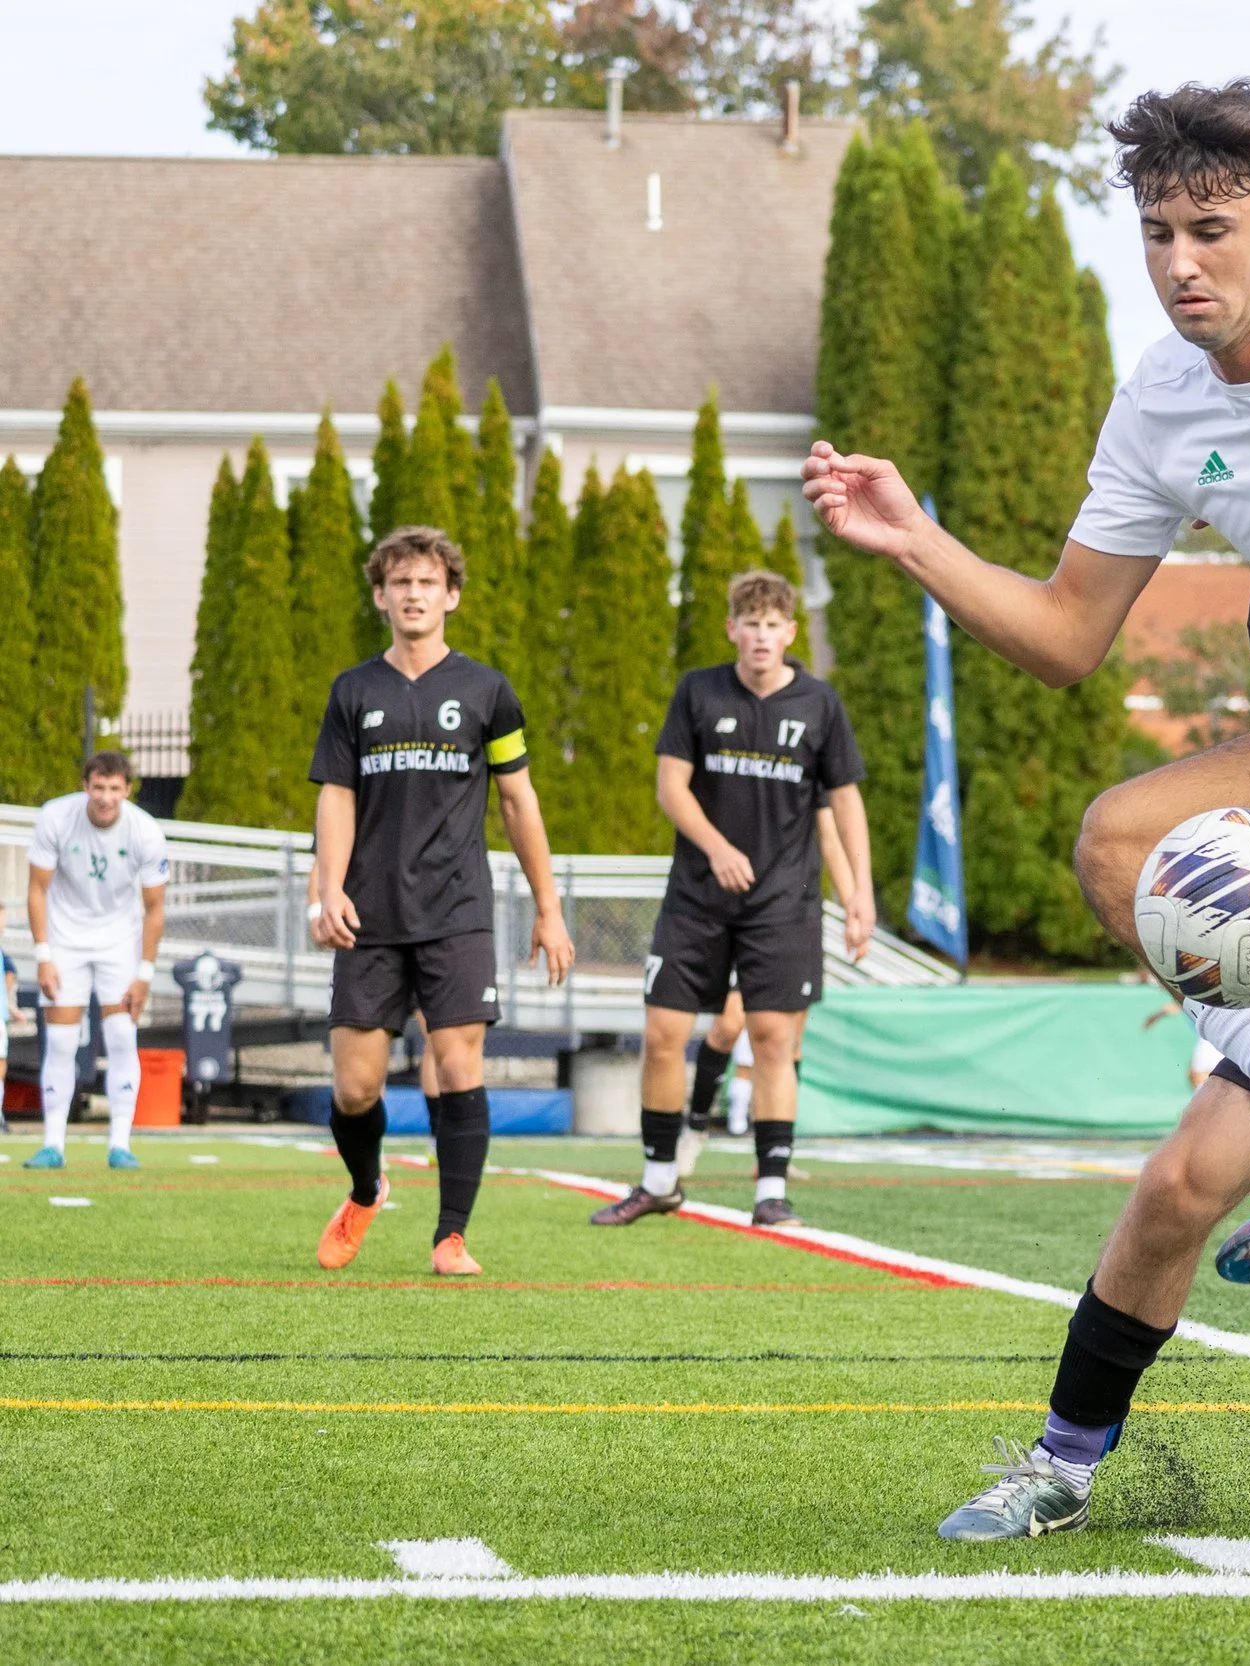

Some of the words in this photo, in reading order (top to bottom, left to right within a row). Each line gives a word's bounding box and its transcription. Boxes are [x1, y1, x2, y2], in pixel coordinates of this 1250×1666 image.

[1198, 470, 1235, 486] adidas
[437, 699, 462, 731] 6
[777, 719, 806, 748] 17
[360, 751, 393, 777] NEW
[394, 748, 470, 773] ENGLAND
